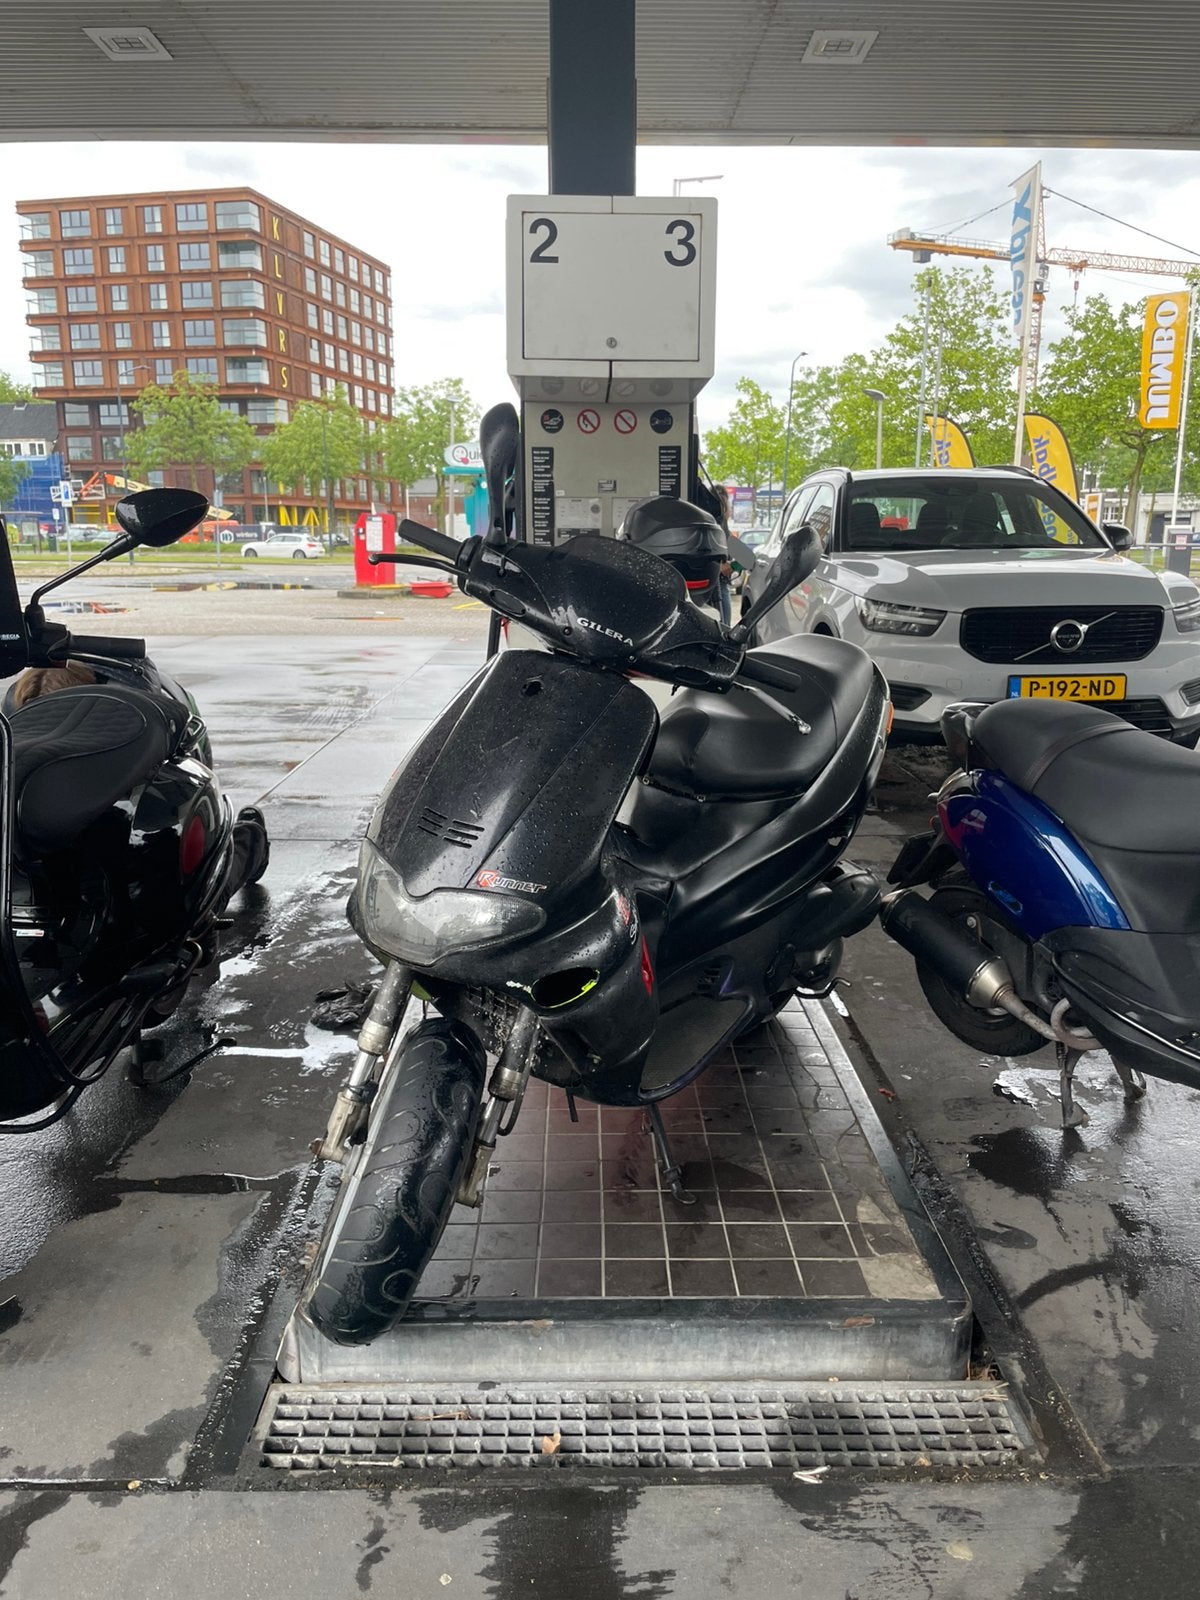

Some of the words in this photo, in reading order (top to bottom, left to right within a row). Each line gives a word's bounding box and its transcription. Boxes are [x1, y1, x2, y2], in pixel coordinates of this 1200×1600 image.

[529, 218, 559, 263] 2
[664, 219, 696, 267] 3
[272, 216, 289, 388] KLVRS
[1146, 300, 1178, 424] JUMBO
[452, 445, 481, 464] Qui
[576, 616, 635, 647] GILERA
[1029, 680, 1116, 697] P-192-ND
